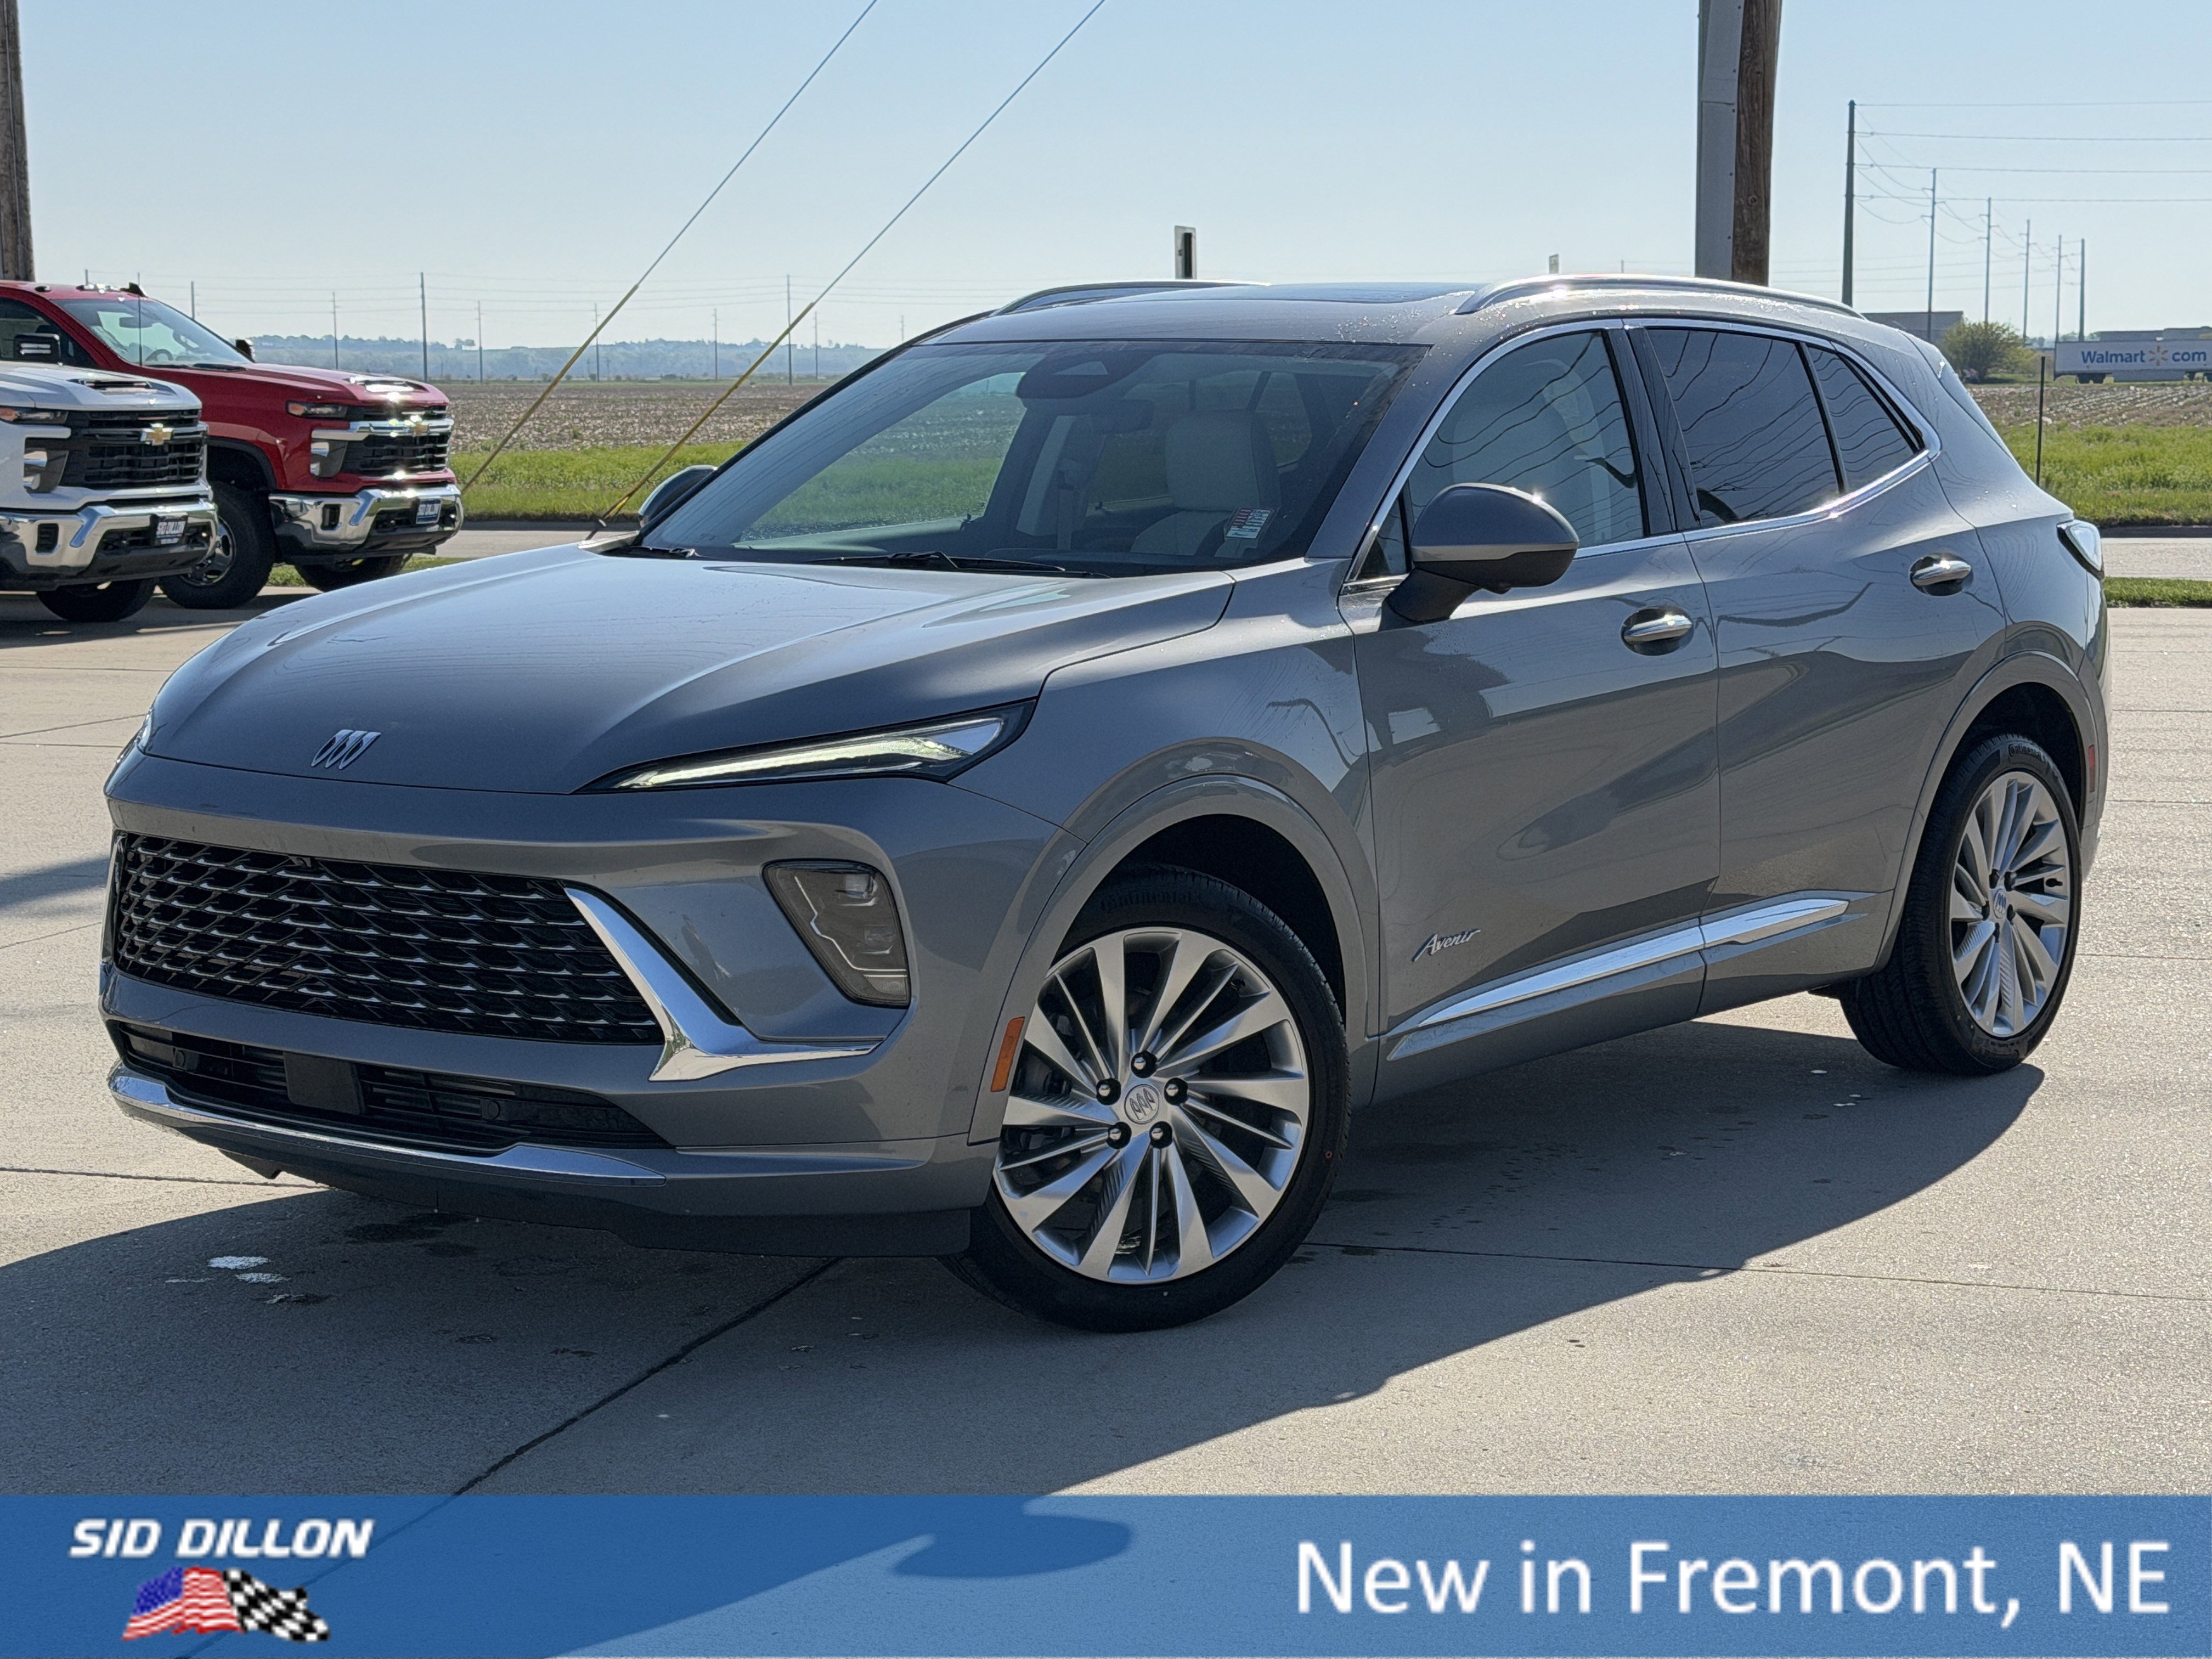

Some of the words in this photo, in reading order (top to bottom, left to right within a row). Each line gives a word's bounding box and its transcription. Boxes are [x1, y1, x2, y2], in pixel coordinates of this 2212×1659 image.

[2081, 349, 2146, 364] Walmart
[2171, 351, 2207, 362] com
[1411, 928, 1481, 962] Avenir
